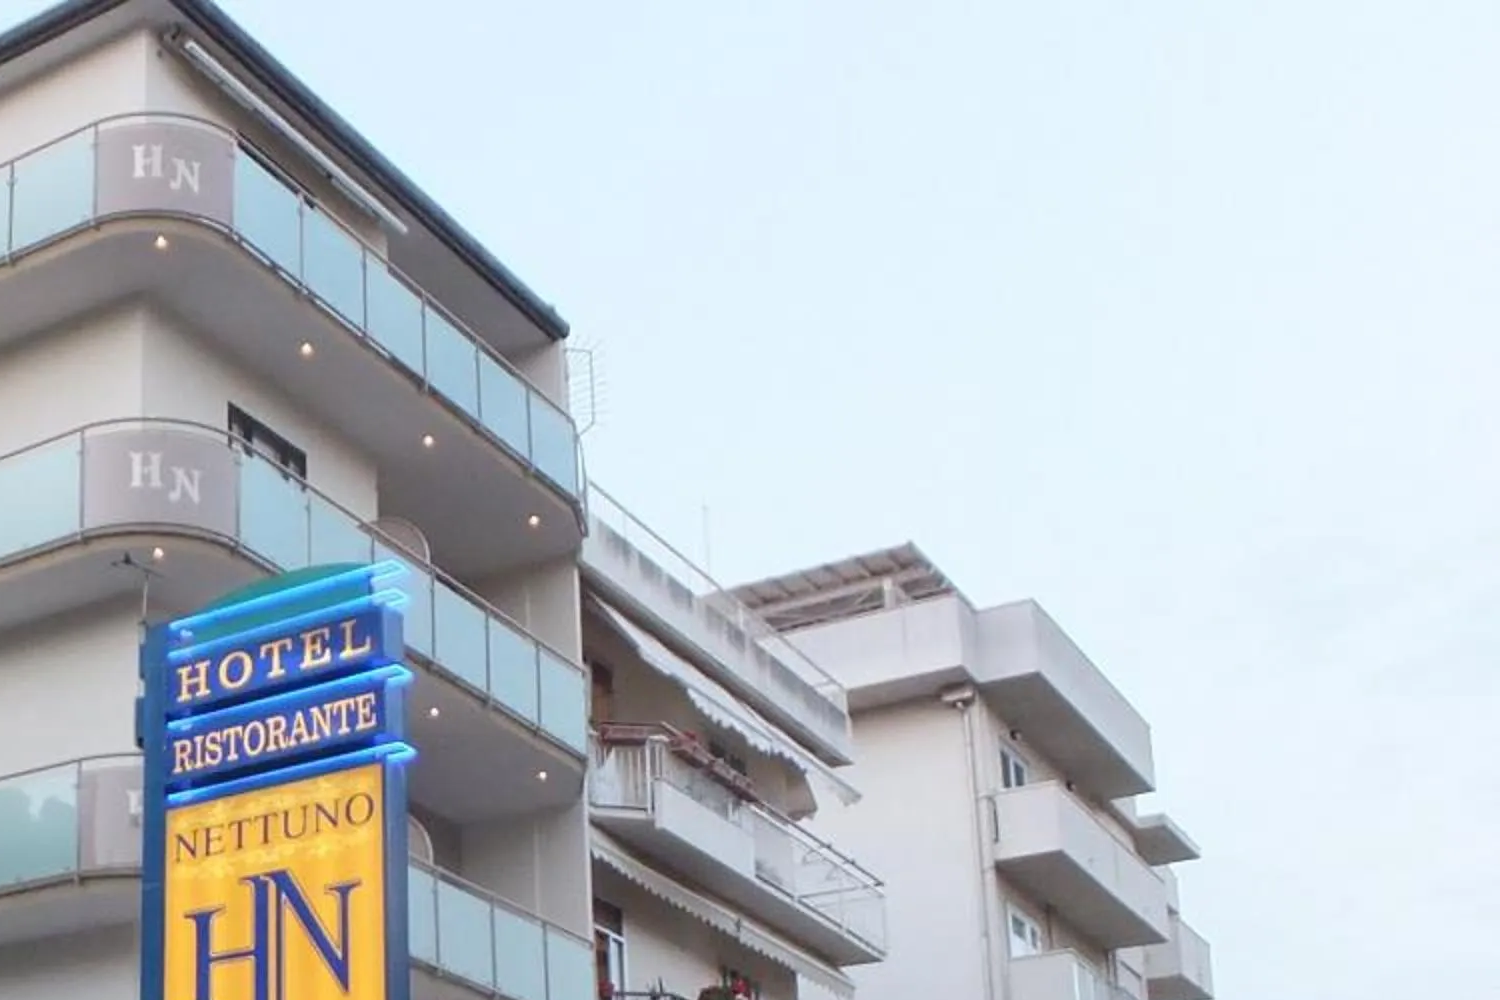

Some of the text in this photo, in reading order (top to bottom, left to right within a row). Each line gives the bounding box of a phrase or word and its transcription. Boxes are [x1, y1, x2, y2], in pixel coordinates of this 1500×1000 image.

[131, 143, 202, 193] HN
[128, 451, 204, 504] HN
[176, 618, 372, 702] HOTEL
[172, 692, 377, 774] RISTORANTE
[175, 792, 374, 863] NETTUNO
